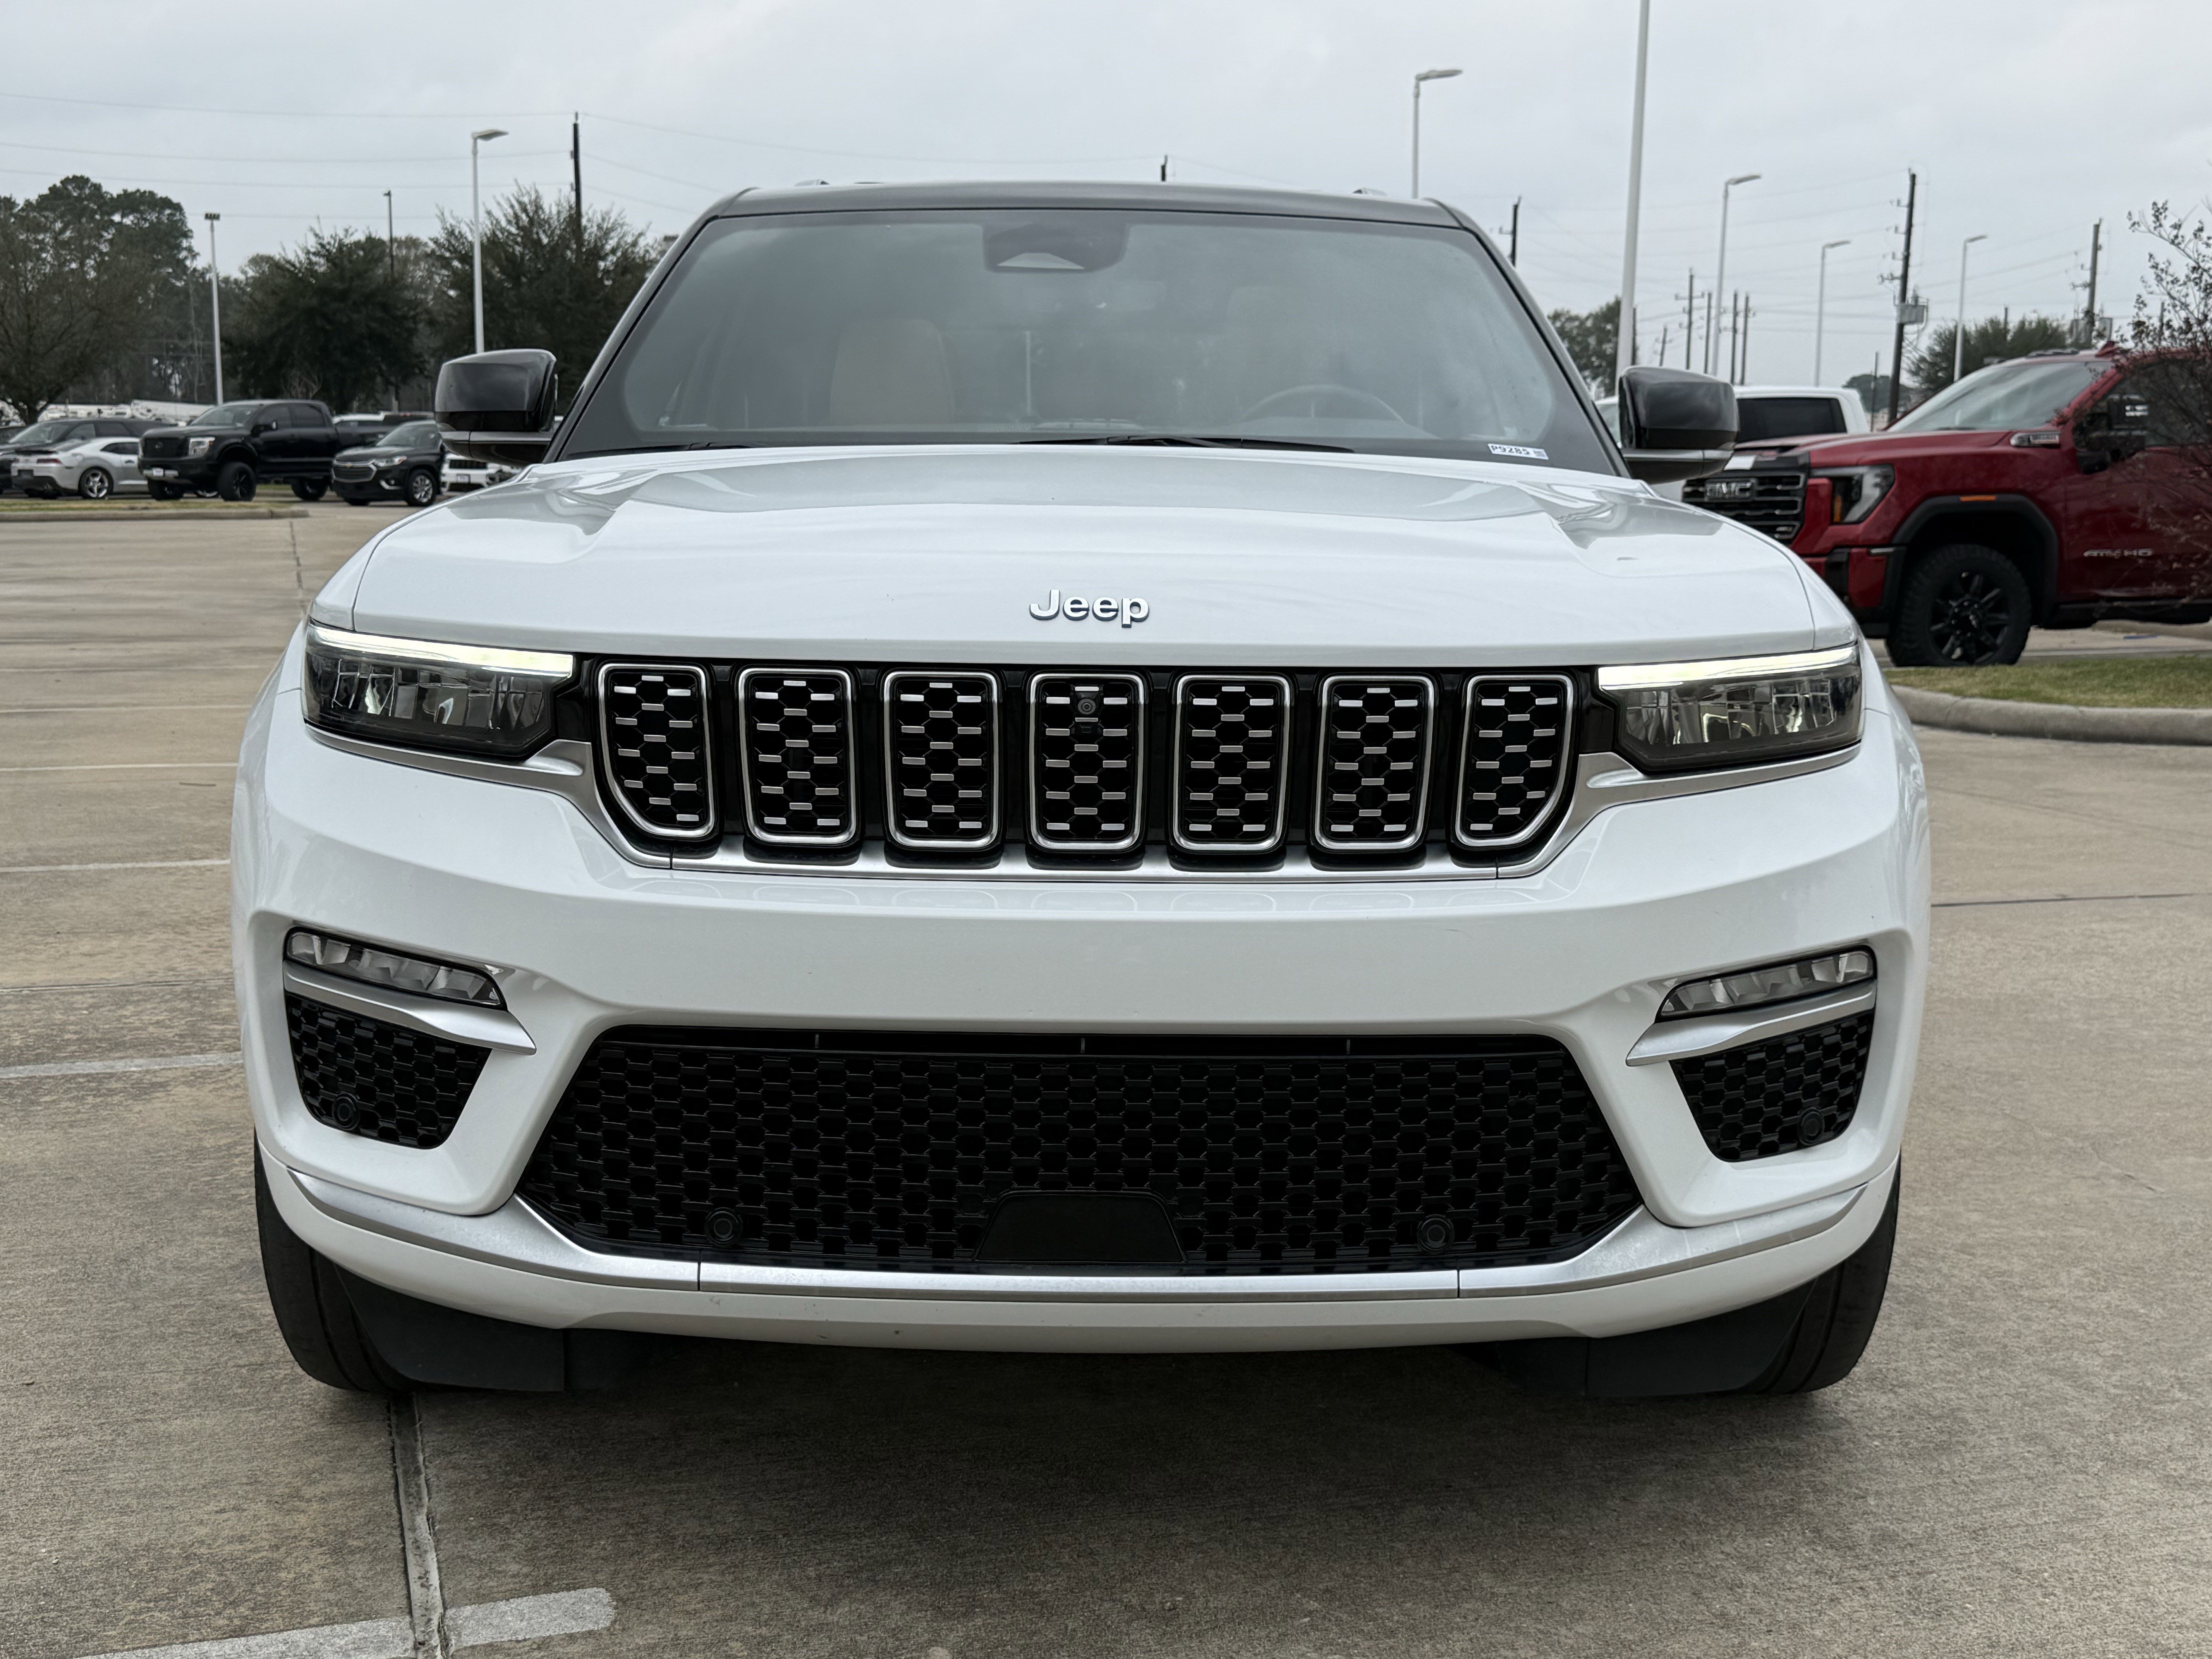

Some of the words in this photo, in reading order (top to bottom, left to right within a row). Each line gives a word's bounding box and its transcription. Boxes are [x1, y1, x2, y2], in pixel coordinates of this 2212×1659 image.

[1491, 445, 1530, 455] P9285
[1706, 482, 1752, 497] GMC
[1029, 589, 1150, 628] Jeep
